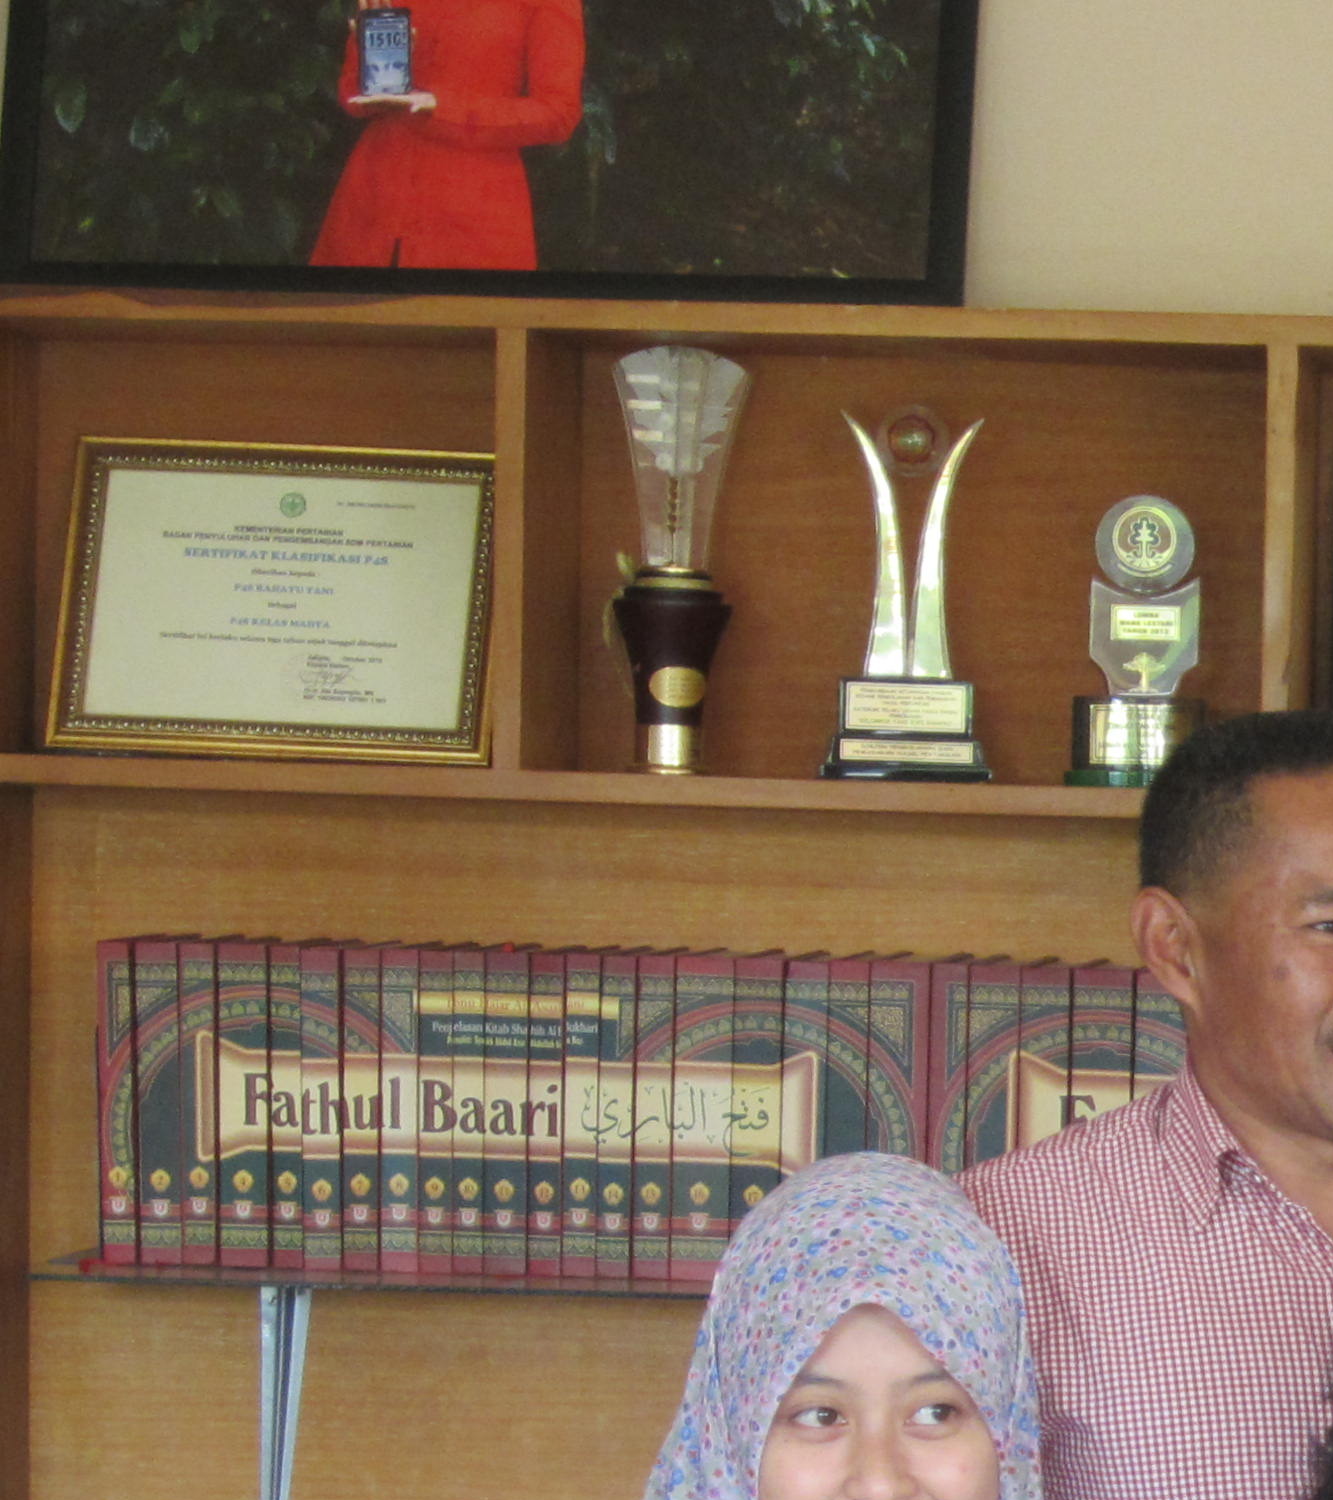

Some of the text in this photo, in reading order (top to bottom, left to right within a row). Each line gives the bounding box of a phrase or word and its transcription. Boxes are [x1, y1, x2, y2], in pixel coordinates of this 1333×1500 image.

[485, 1021, 510, 1036] Kitab
[558, 1020, 598, 1037] Bkhari
[243, 1073, 563, 1138] Fathul Baari
